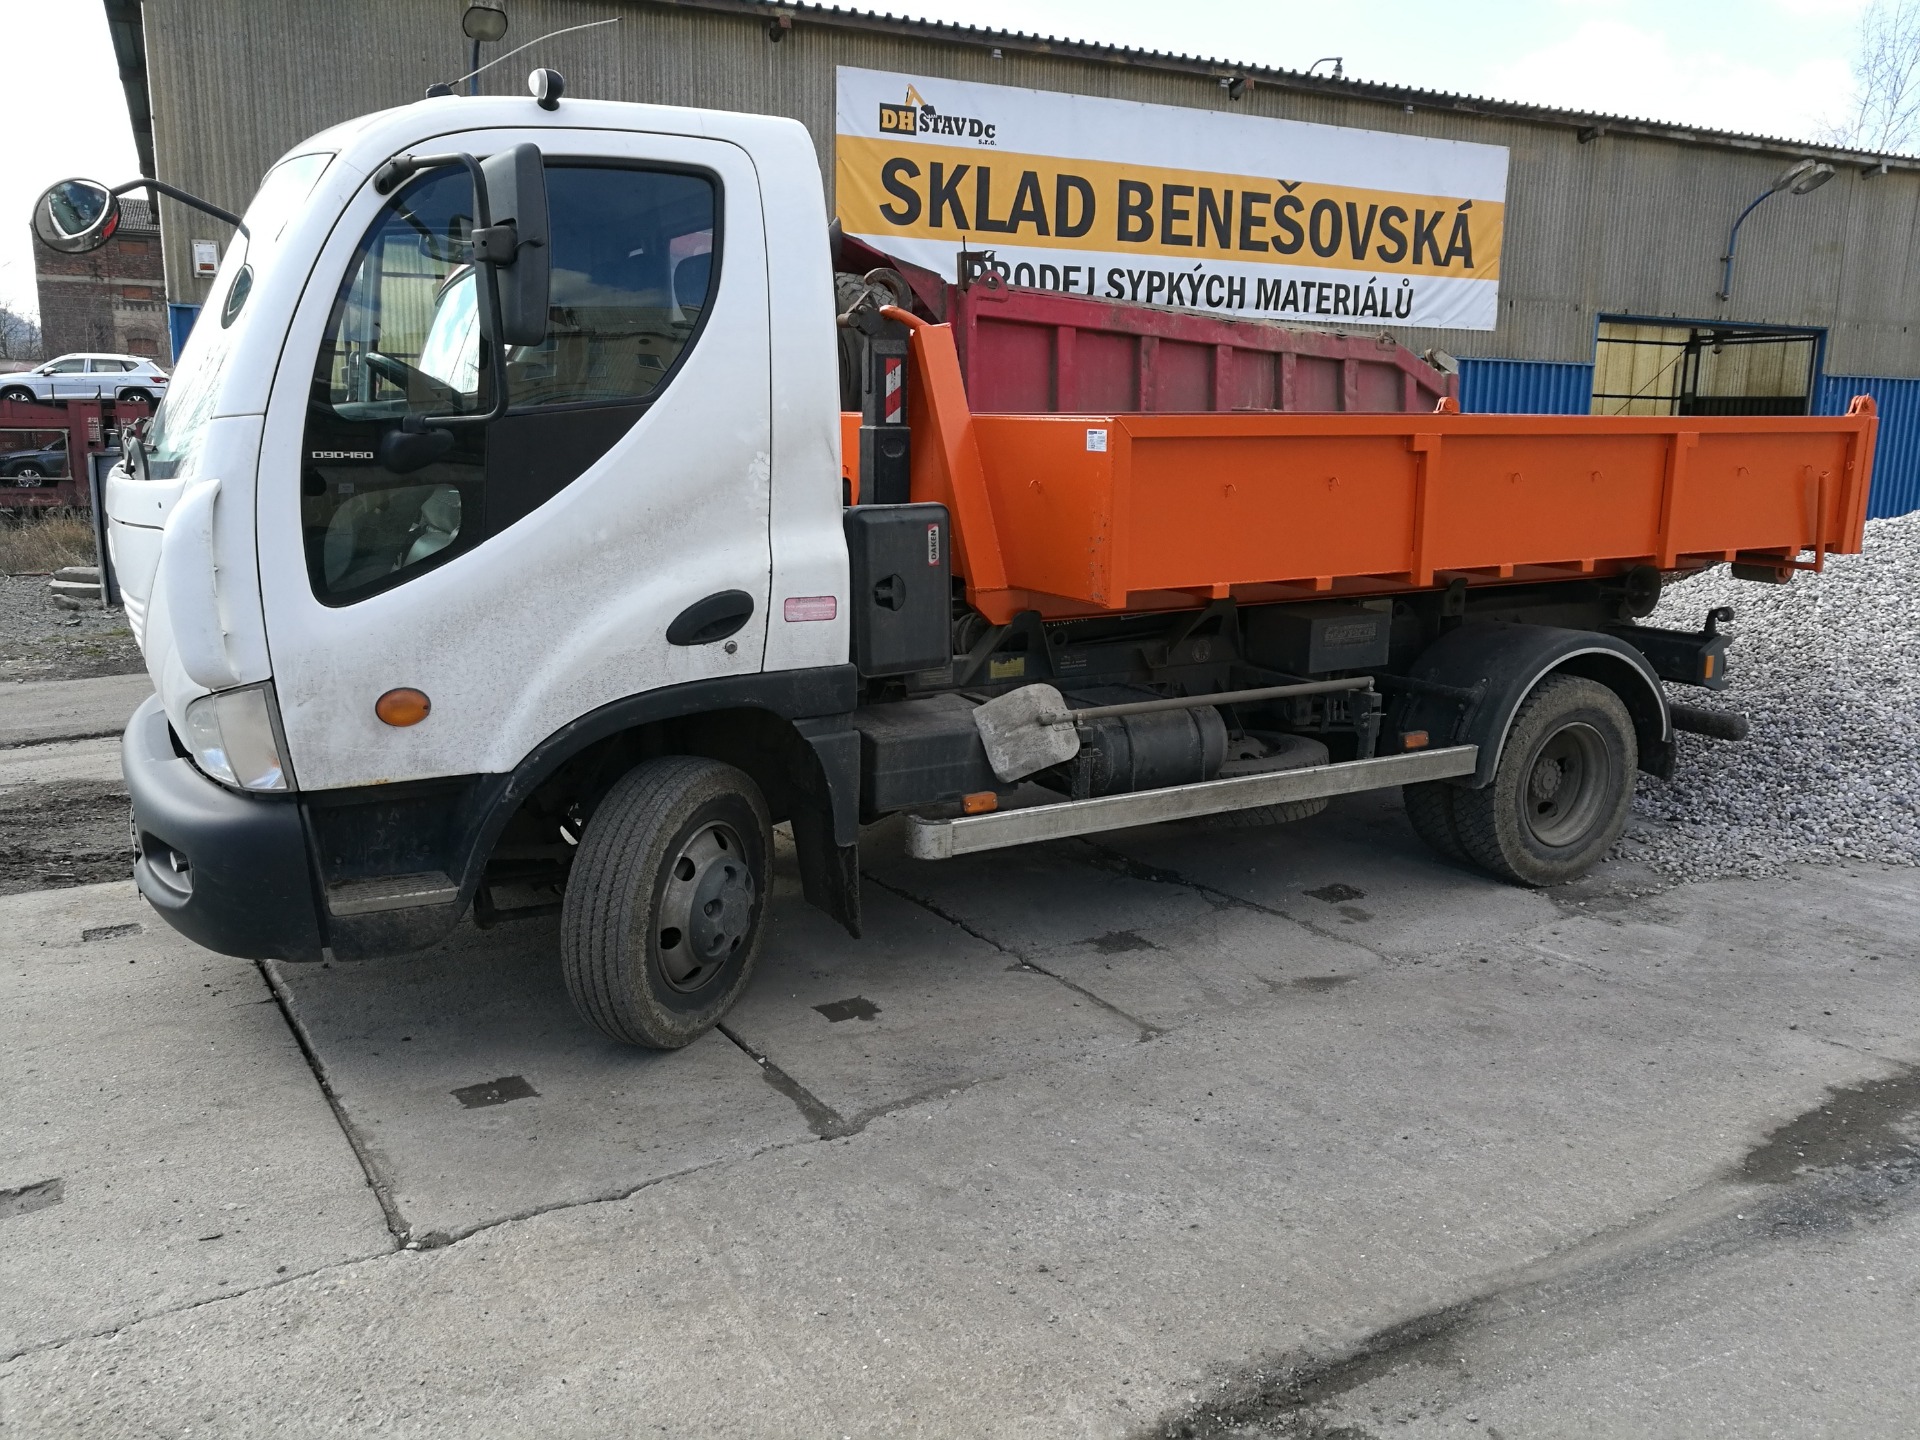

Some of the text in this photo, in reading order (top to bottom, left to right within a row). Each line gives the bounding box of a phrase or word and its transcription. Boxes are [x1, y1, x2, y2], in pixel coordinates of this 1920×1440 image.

[881, 108, 915, 131] DH
[879, 157, 1474, 269] SKLAD BENEŠOVSKÁ
[1105, 263, 1246, 309] SYPKÝCH
[1255, 276, 1415, 319] MATERIÁLŮ
